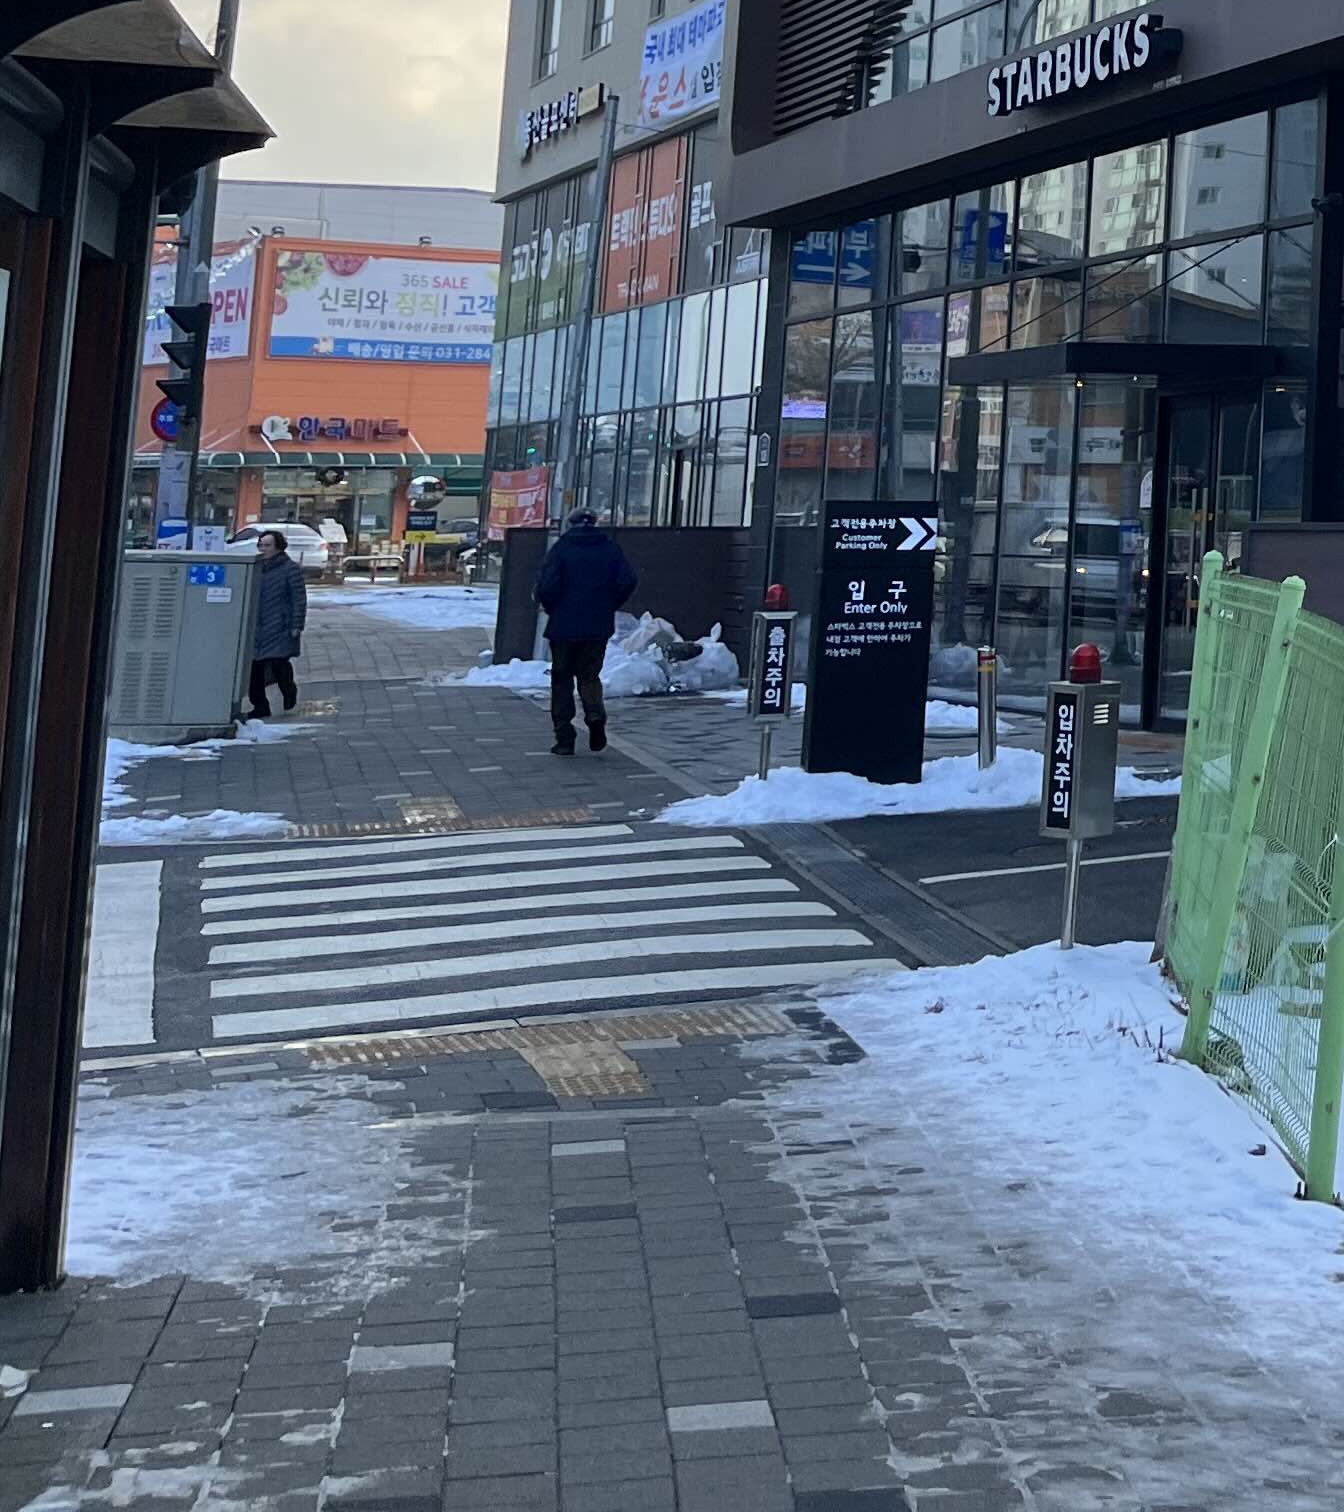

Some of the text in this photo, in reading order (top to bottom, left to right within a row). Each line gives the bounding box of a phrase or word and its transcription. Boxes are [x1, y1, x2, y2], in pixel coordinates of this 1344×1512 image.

[987, 13, 1150, 116] STARBUCKS
[401, 274, 469, 289] 365 SALE
[208, 287, 248, 325] PEN
[319, 288, 389, 315] 신뢰와
[397, 292, 448, 317] 정직!
[835, 541, 888, 550] Parking Only
[842, 533, 882, 542] Customer
[207, 572, 216, 583] 3
[844, 601, 908, 614] Enter Only
[763, 626, 786, 707] 출차주의
[1052, 704, 1074, 818] 입차주의
